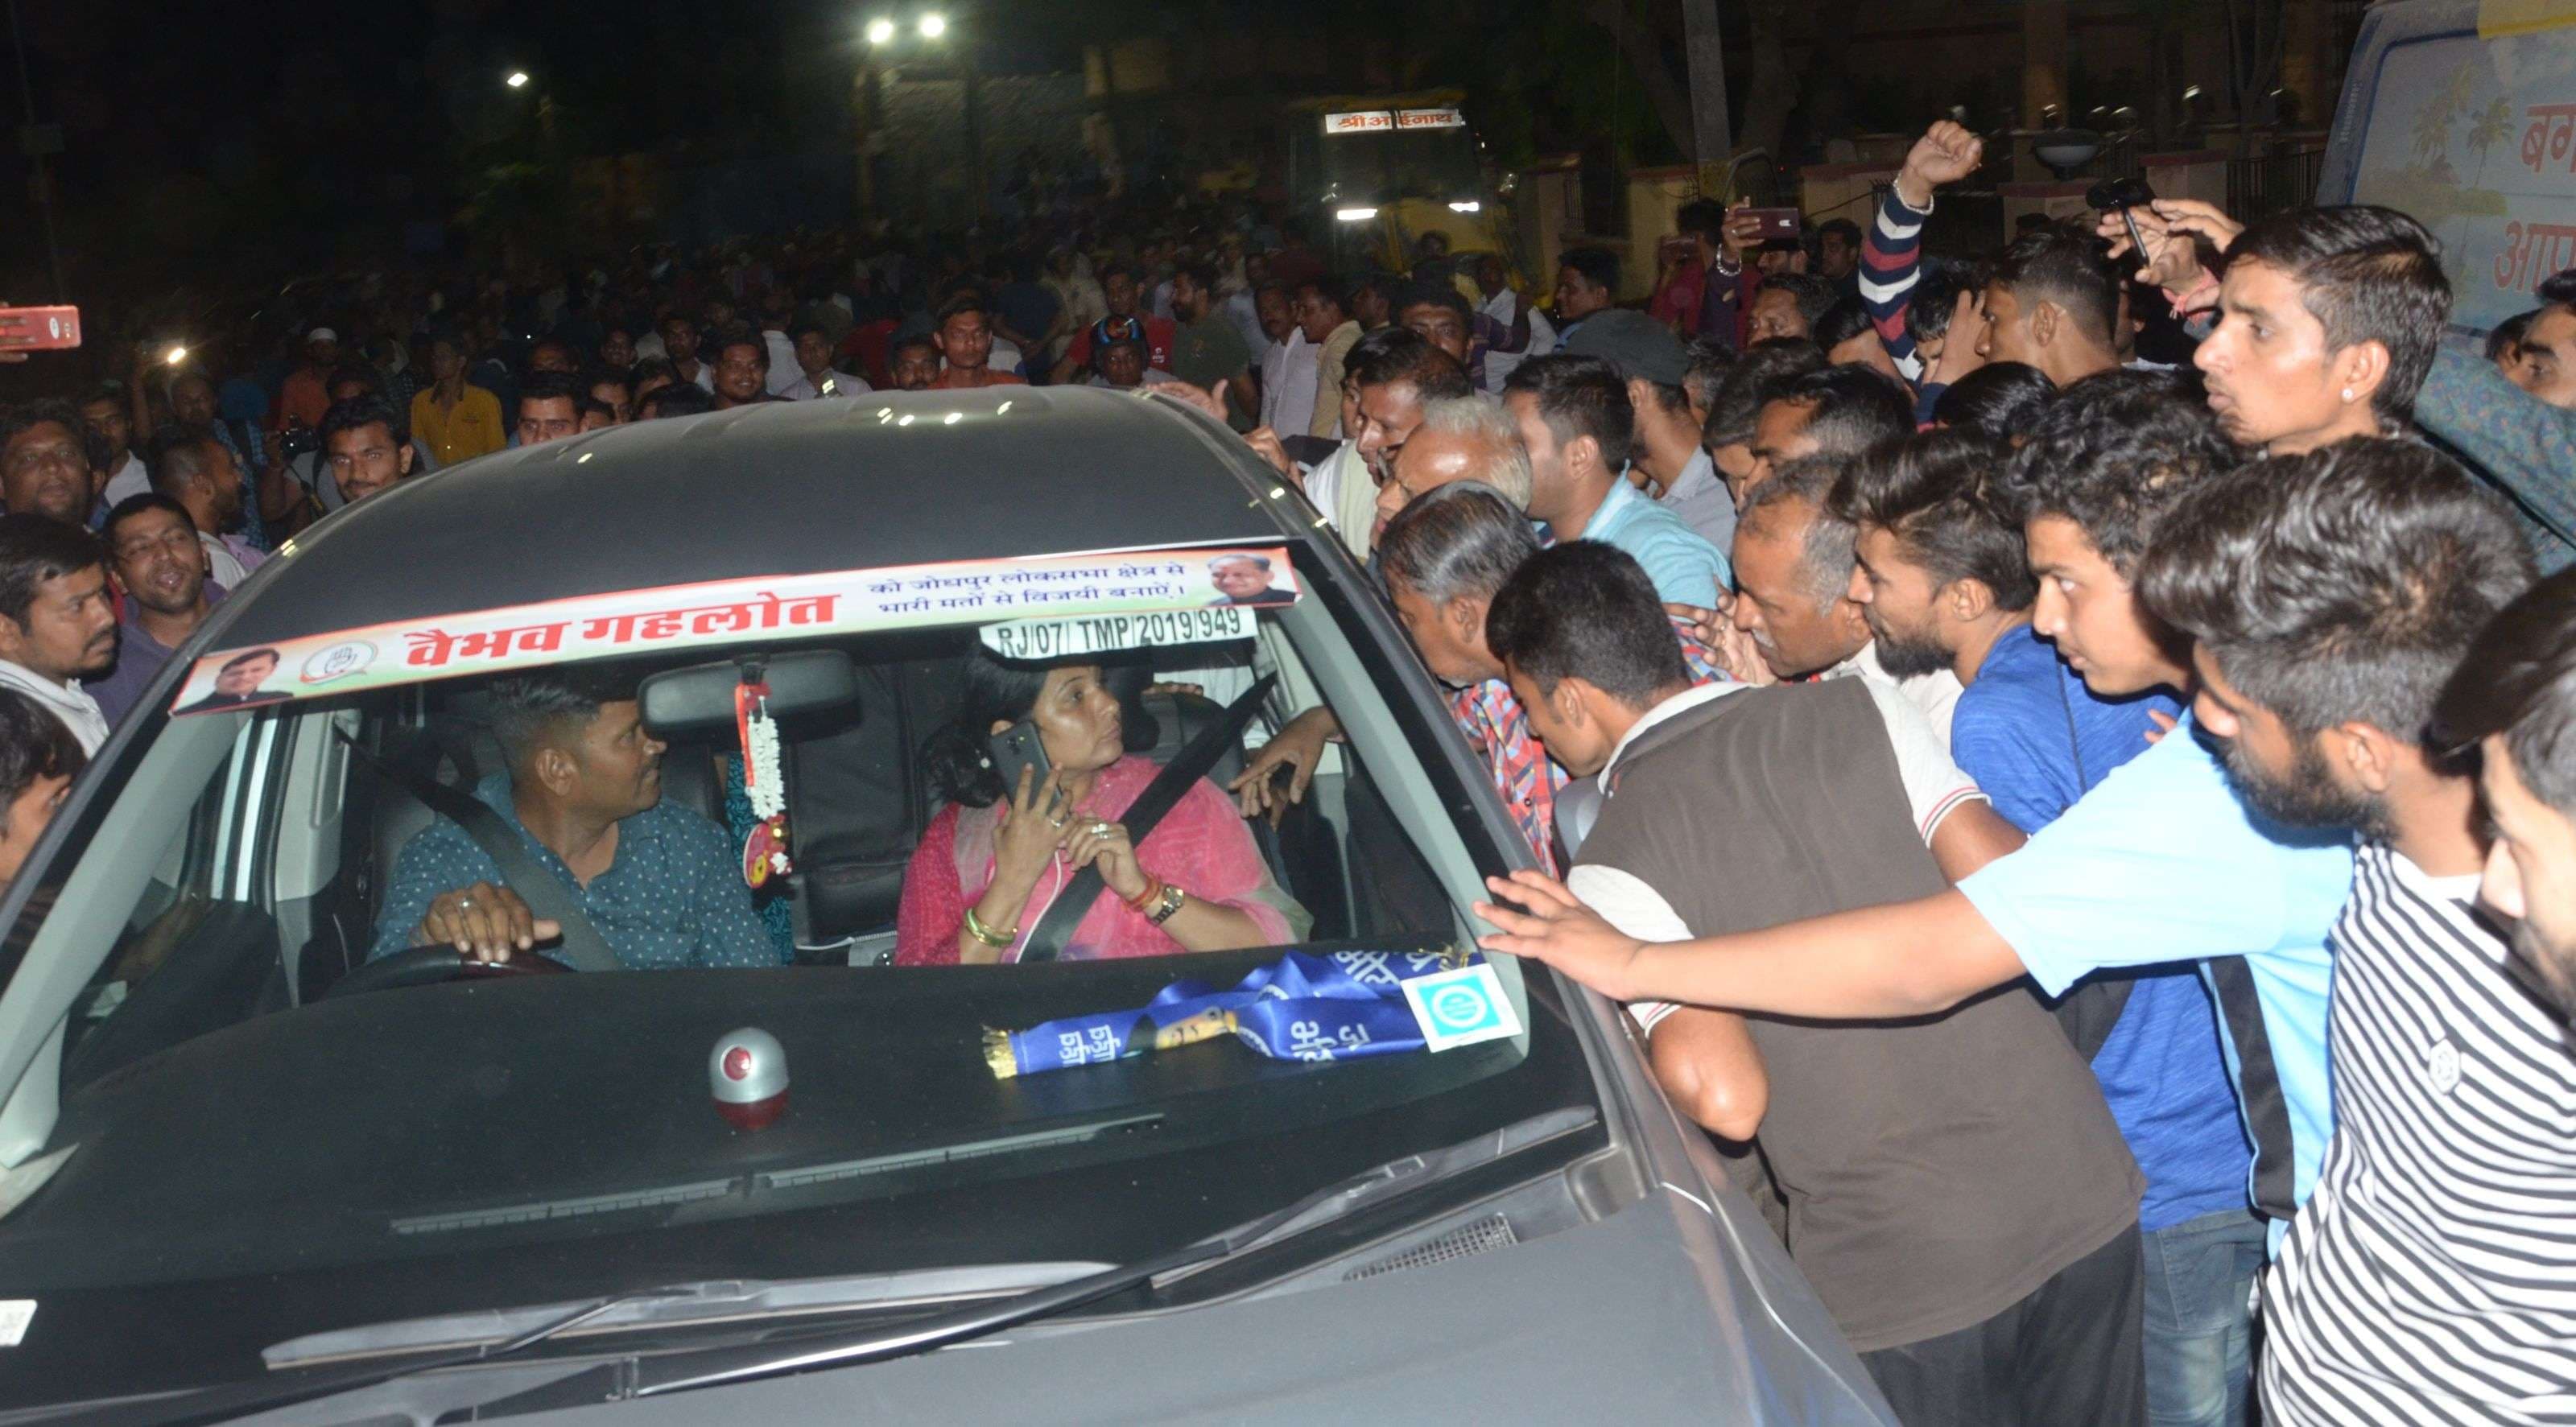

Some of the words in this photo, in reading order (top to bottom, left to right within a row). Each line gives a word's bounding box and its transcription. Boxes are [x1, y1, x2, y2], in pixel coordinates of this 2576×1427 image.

[868, 578, 902, 593] को
[910, 575, 991, 590] जोधपुर
[1000, 567, 1109, 584] लोकसभा
[1117, 563, 1158, 579] क्षेत्र
[1165, 561, 1186, 575] से
[878, 595, 930, 612] भारी
[938, 591, 985, 608] मतों
[993, 590, 1013, 604] से
[1022, 585, 1100, 604] विजयी
[403, 621, 572, 666] वैभव
[583, 592, 841, 643] गहलोत
